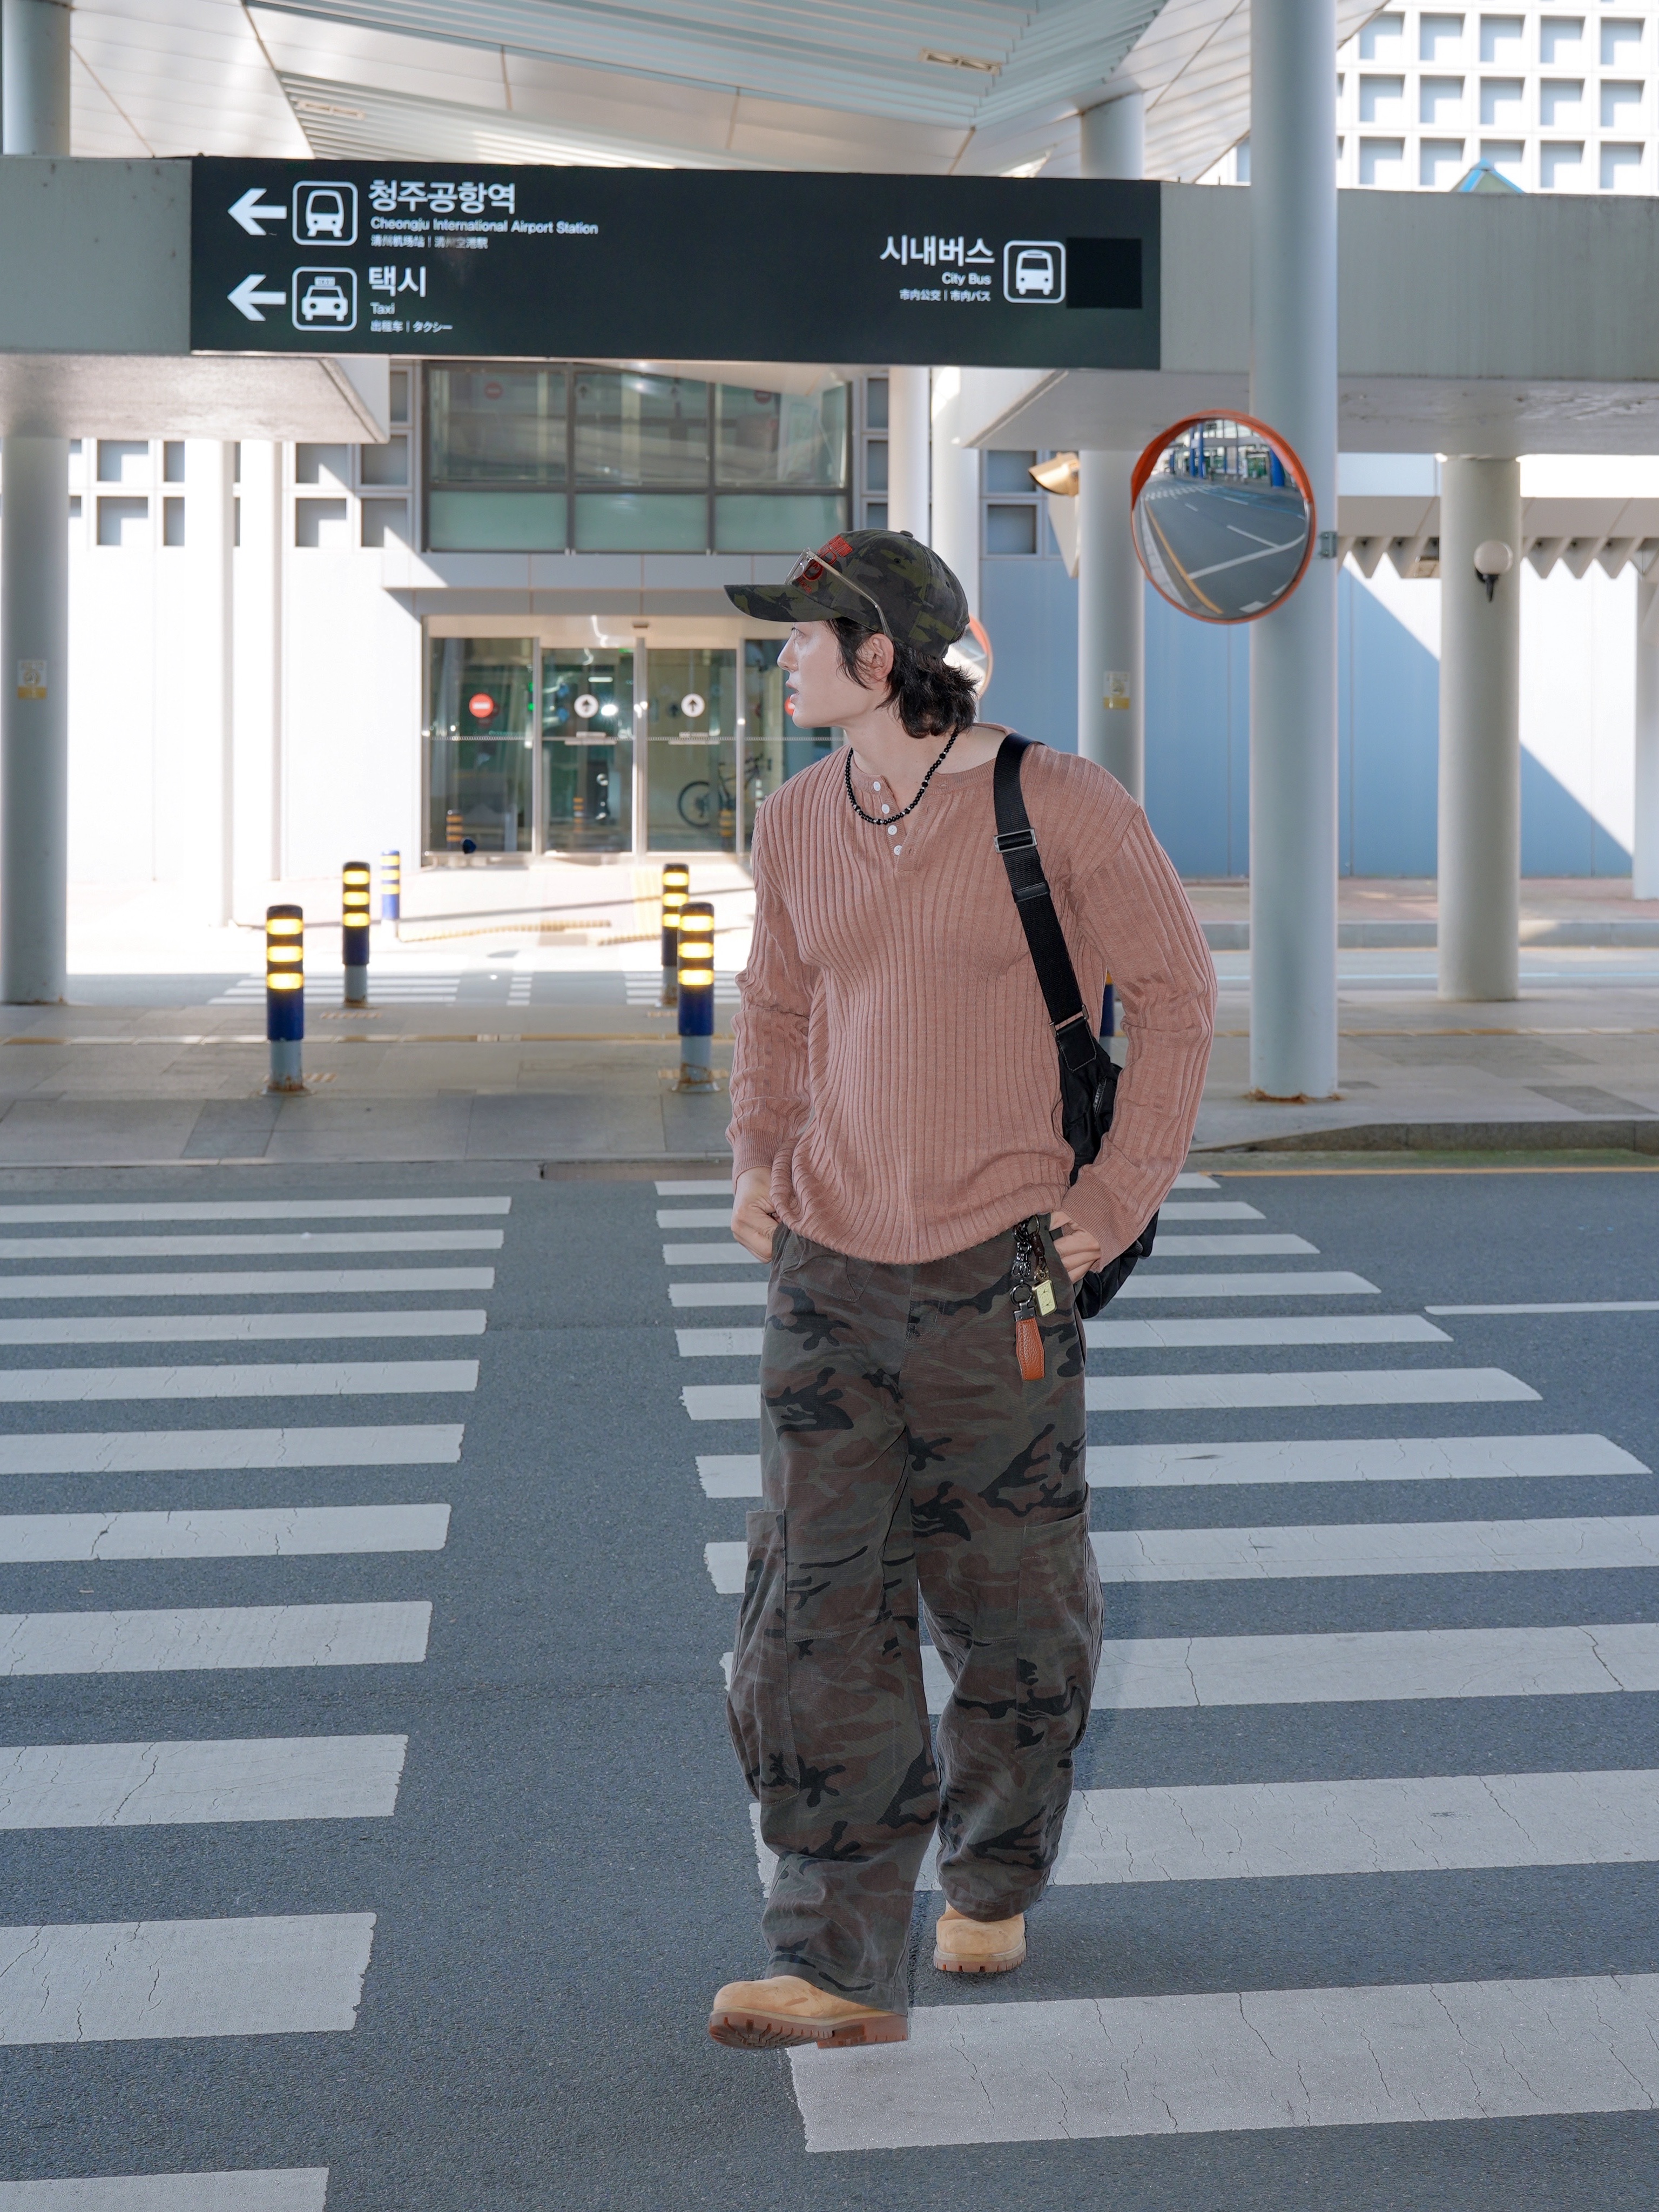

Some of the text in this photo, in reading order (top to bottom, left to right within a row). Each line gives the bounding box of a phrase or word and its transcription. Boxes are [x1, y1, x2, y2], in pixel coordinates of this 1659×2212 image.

[368, 179, 515, 214] 청주공항역
[370, 216, 599, 234] Cheongju International Airport Station
[879, 234, 995, 267] 시내버스
[368, 265, 426, 297] 택시
[941, 272, 992, 286] City Bus
[370, 302, 395, 314] Taxi
